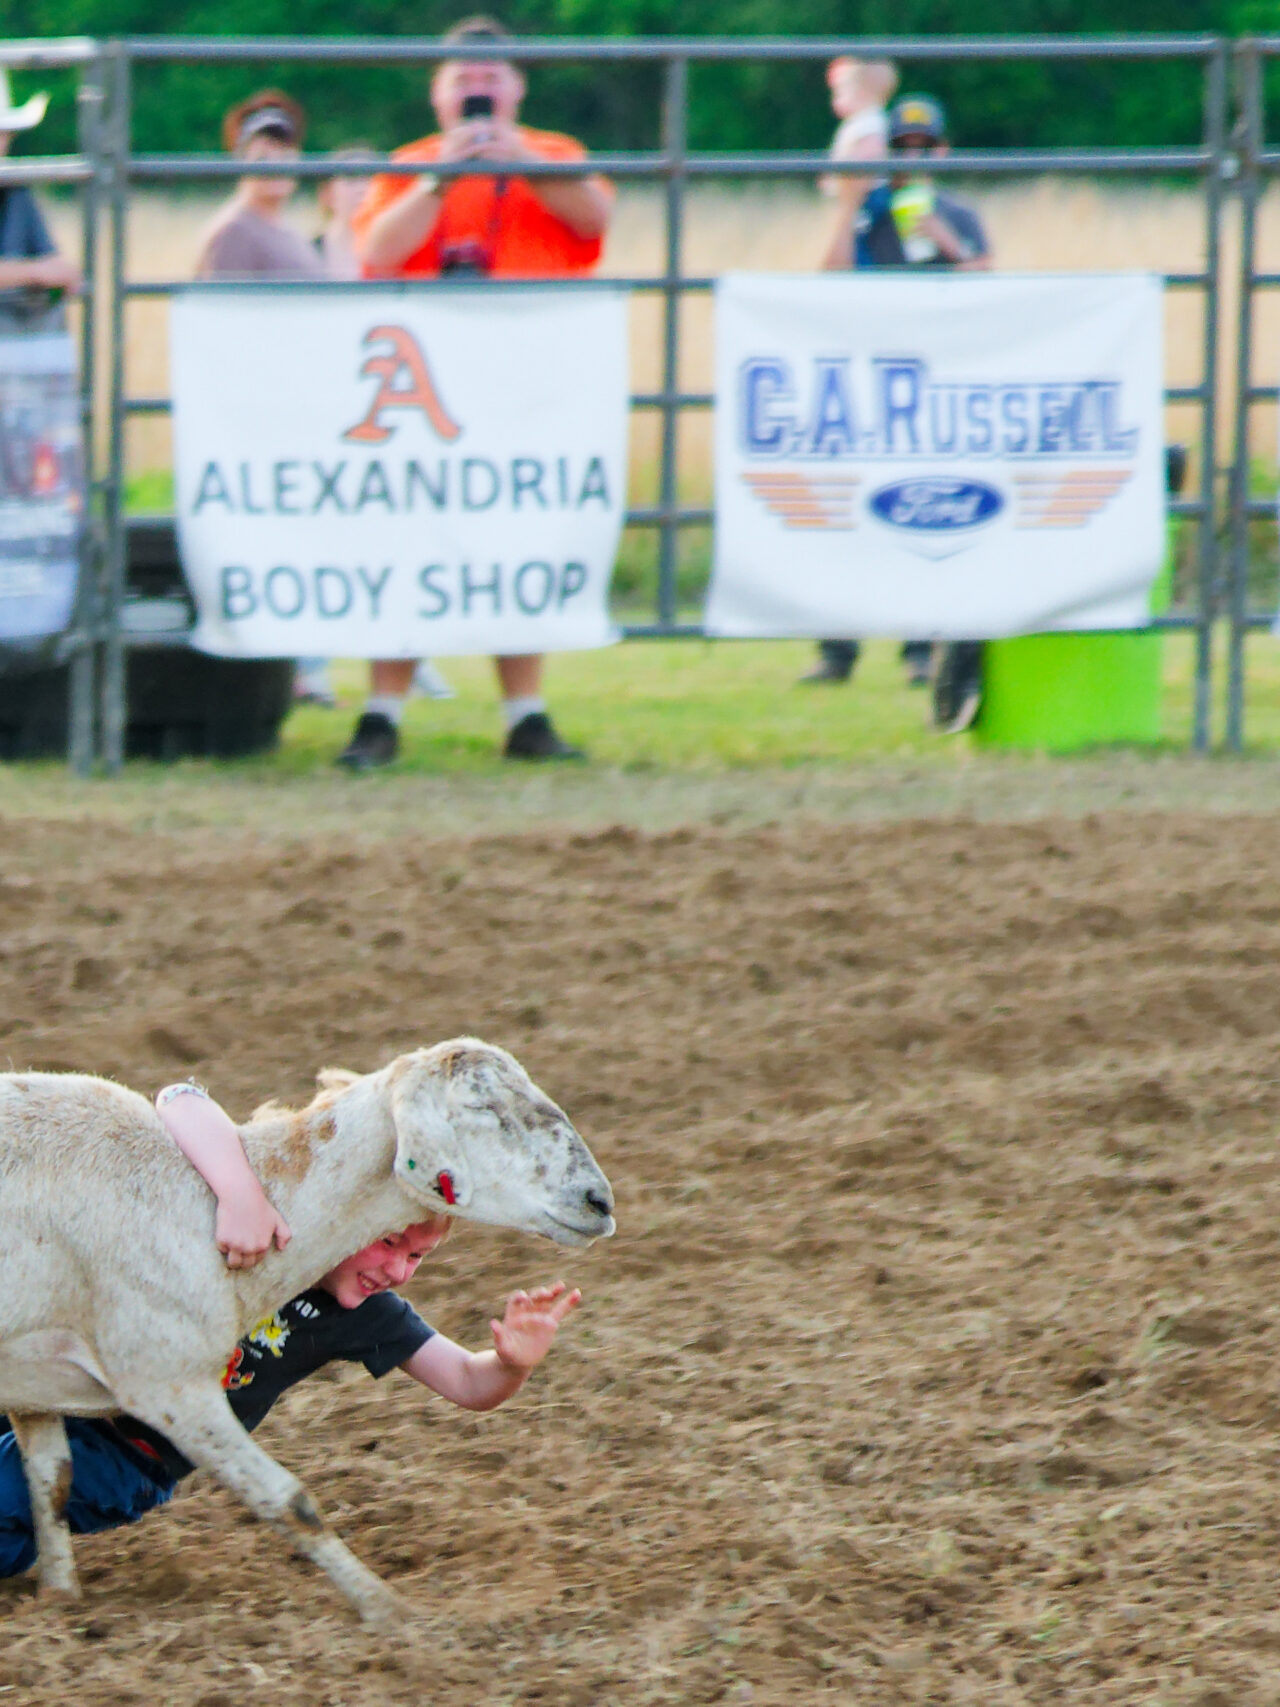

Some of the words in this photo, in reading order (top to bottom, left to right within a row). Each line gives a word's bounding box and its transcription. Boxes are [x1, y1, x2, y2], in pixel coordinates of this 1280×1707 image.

[191, 455, 613, 516] ALEXANDRIA
[888, 479, 986, 527] Ford
[220, 565, 393, 622] BODY
[419, 560, 589, 618] SHOP
